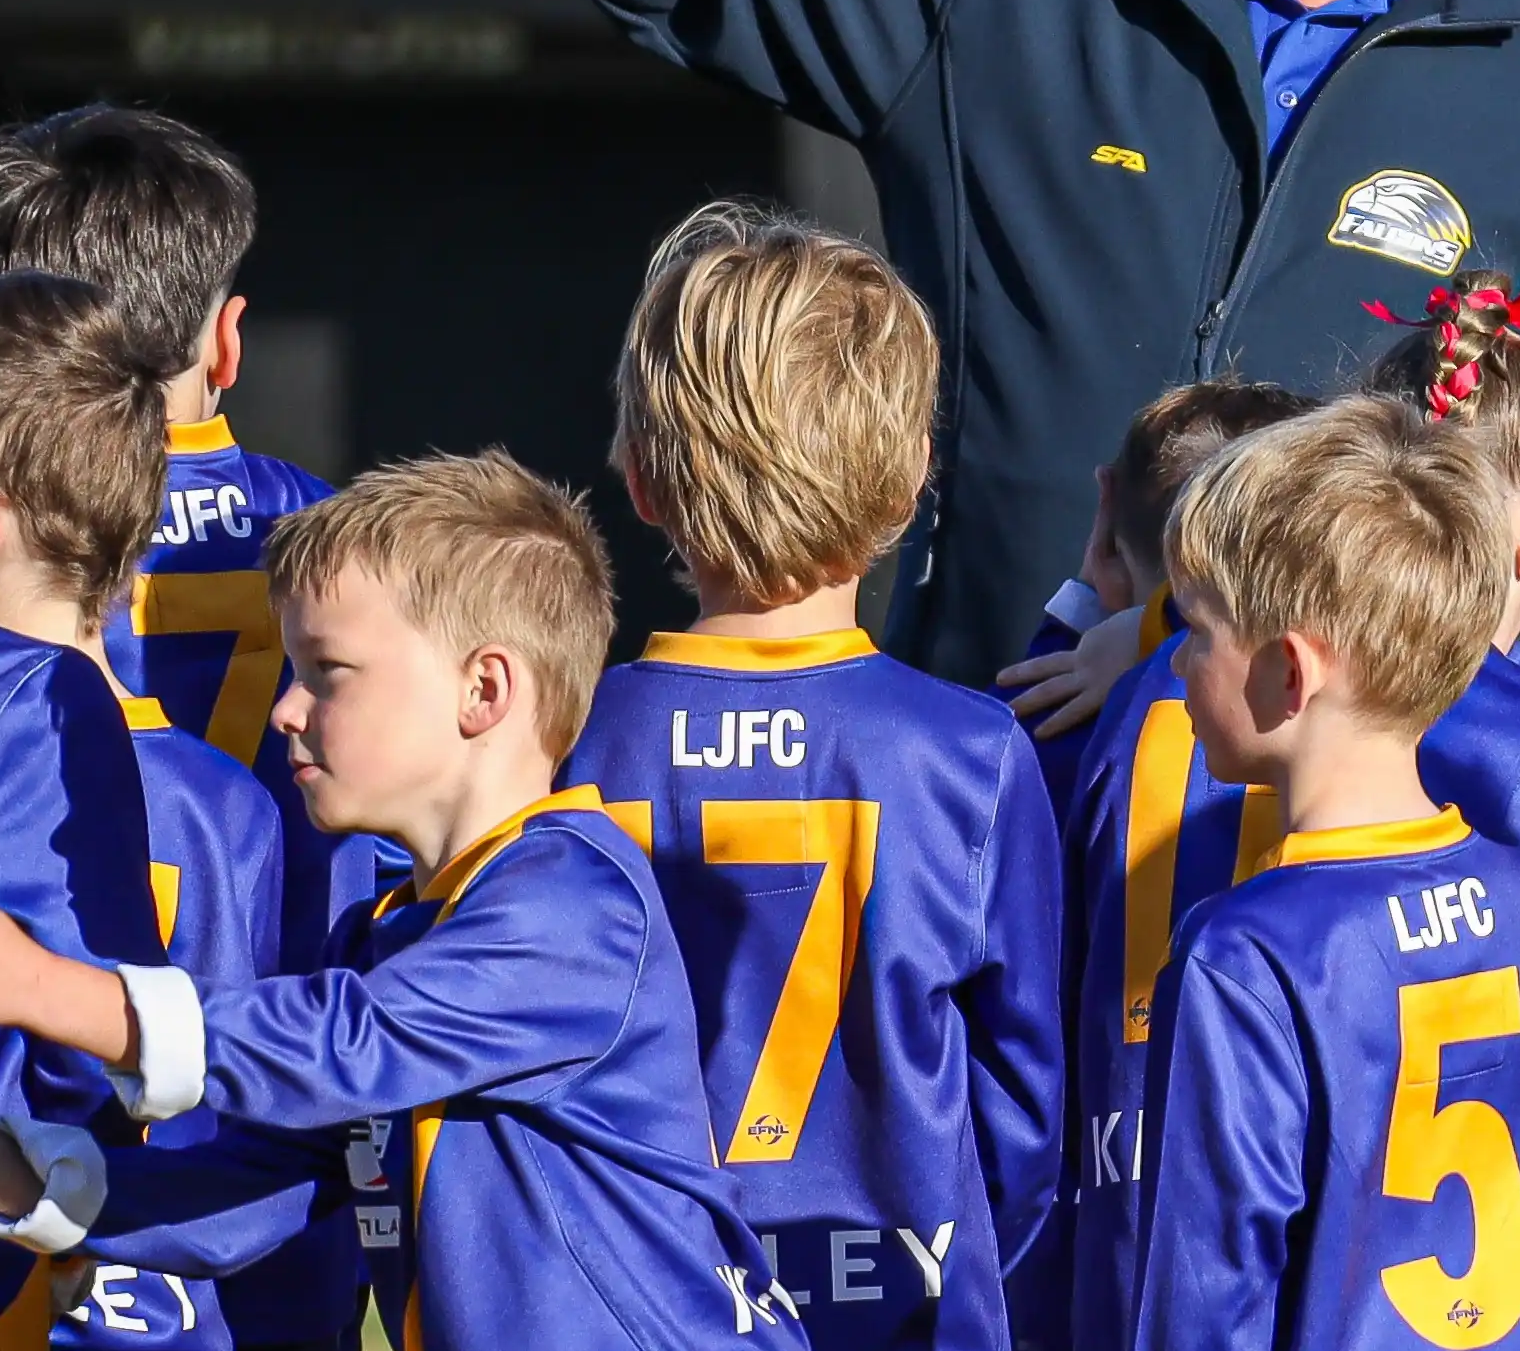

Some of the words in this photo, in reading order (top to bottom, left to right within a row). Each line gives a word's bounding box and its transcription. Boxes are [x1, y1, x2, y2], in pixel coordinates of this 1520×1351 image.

[1091, 145, 1147, 174] SFA
[671, 709, 808, 769] LJFC
[1386, 876, 1496, 953] LJFC
[747, 1124, 790, 1138] EFNL
